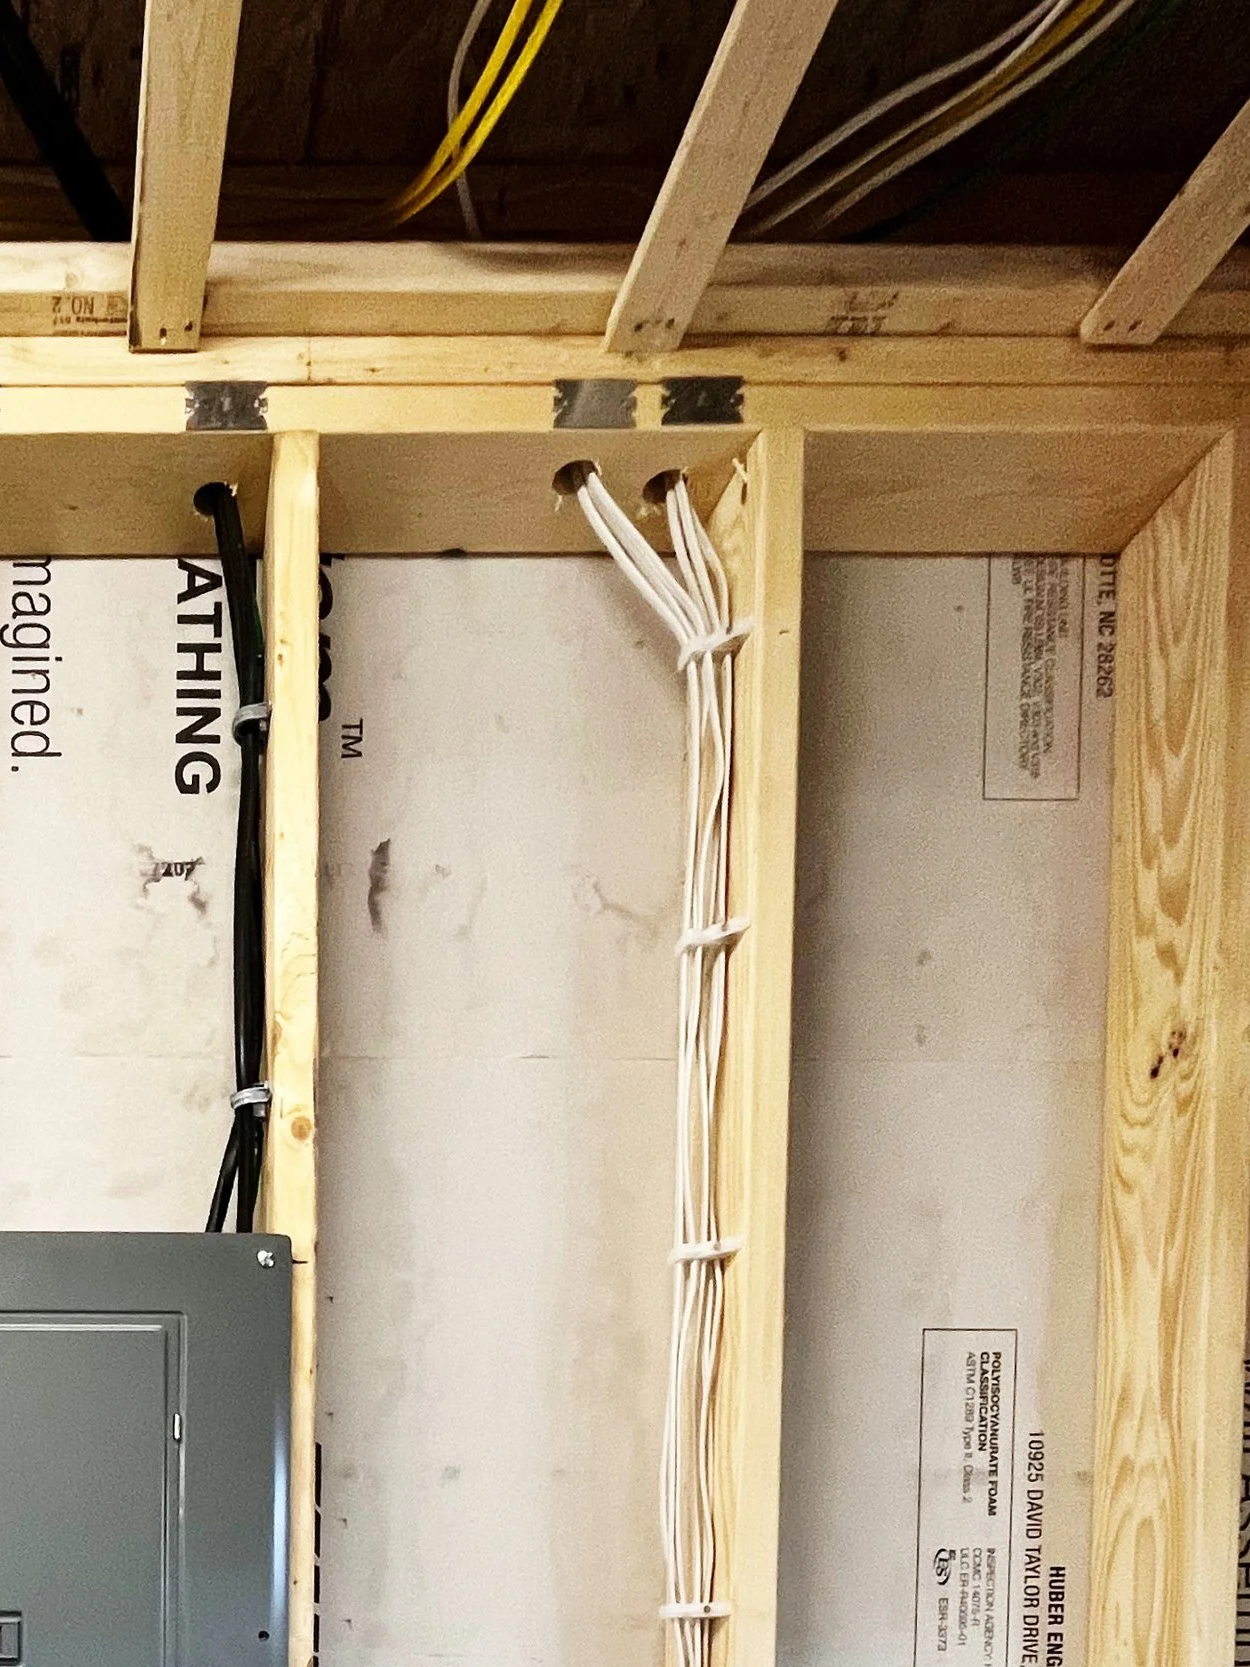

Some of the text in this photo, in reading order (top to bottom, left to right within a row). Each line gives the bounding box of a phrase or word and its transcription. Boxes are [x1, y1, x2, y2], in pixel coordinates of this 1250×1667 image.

[1099, 611, 1115, 636] NC
[1096, 642, 1114, 698] 28262
[341, 718, 364, 759] TM
[977, 1352, 989, 1452] CLASSIFICATION
[987, 1352, 1002, 1516] POLYISOCYANURATE FOAM
[1027, 1430, 1044, 1482] 10925
[1025, 1490, 1042, 1540] DAVID
[1023, 1545, 1041, 1608] TAYLOR
[1048, 1566, 1066, 1625] HUBER
[1020, 1615, 1039, 1667] DRIVE,
